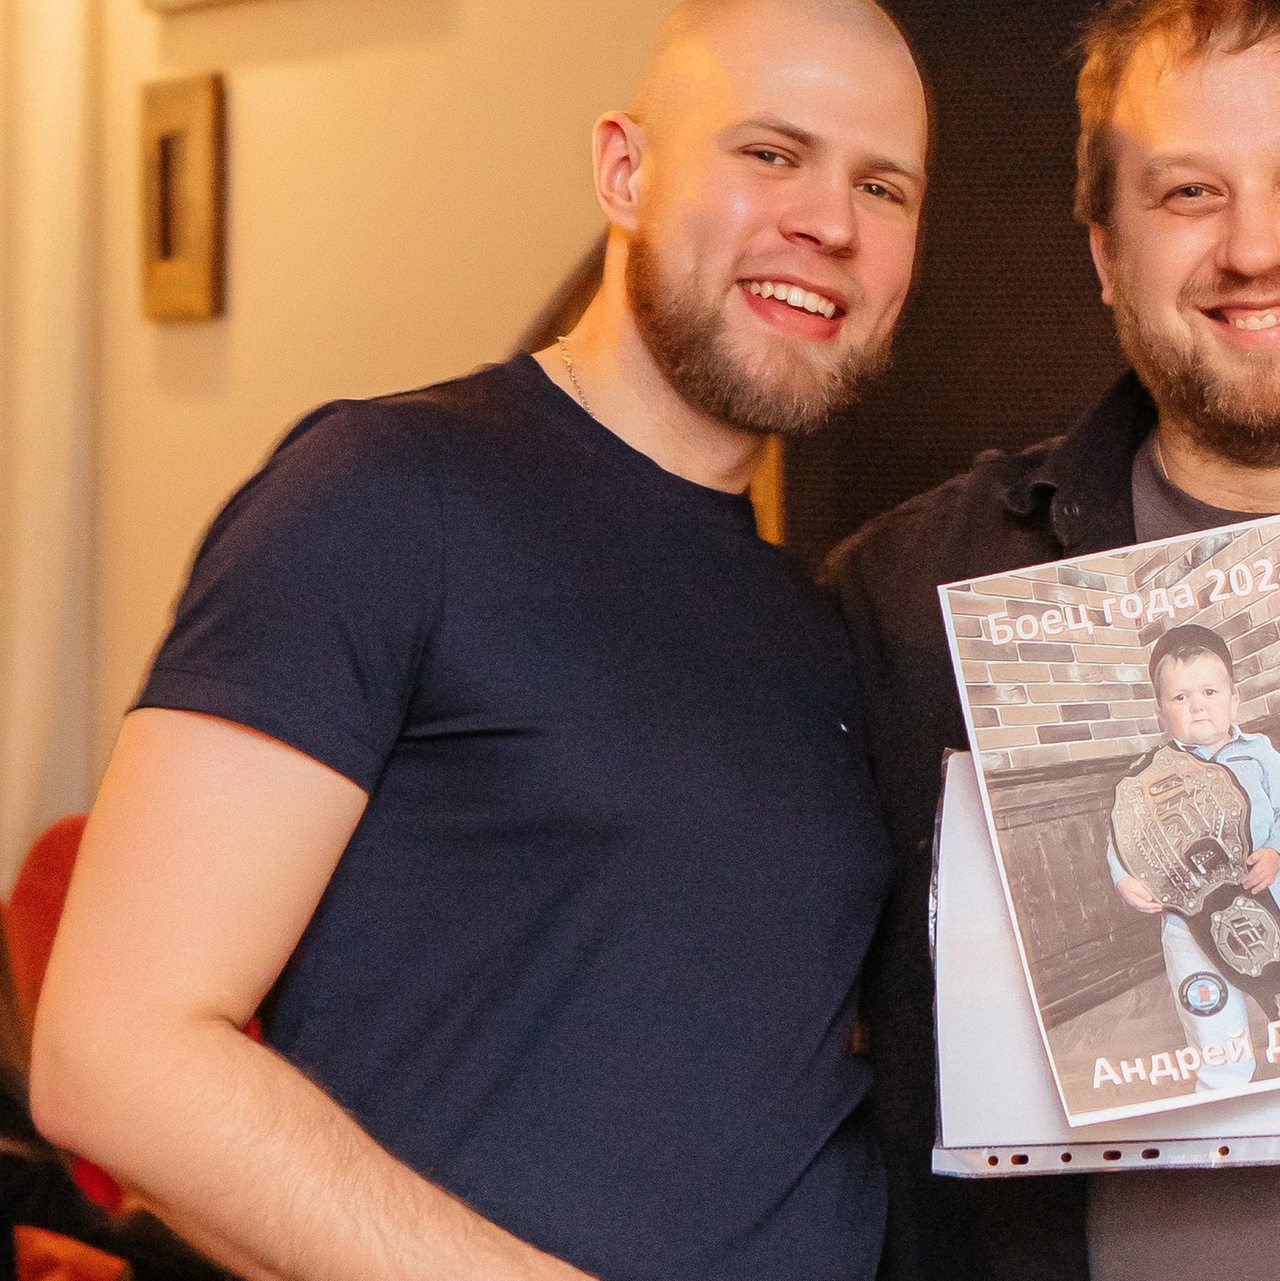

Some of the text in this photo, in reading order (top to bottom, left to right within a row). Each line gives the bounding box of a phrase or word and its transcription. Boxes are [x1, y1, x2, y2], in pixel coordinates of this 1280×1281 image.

[987, 603, 1094, 646] Боец
[1103, 582, 1195, 624] года
[1093, 1028, 1254, 1089] Андрей
